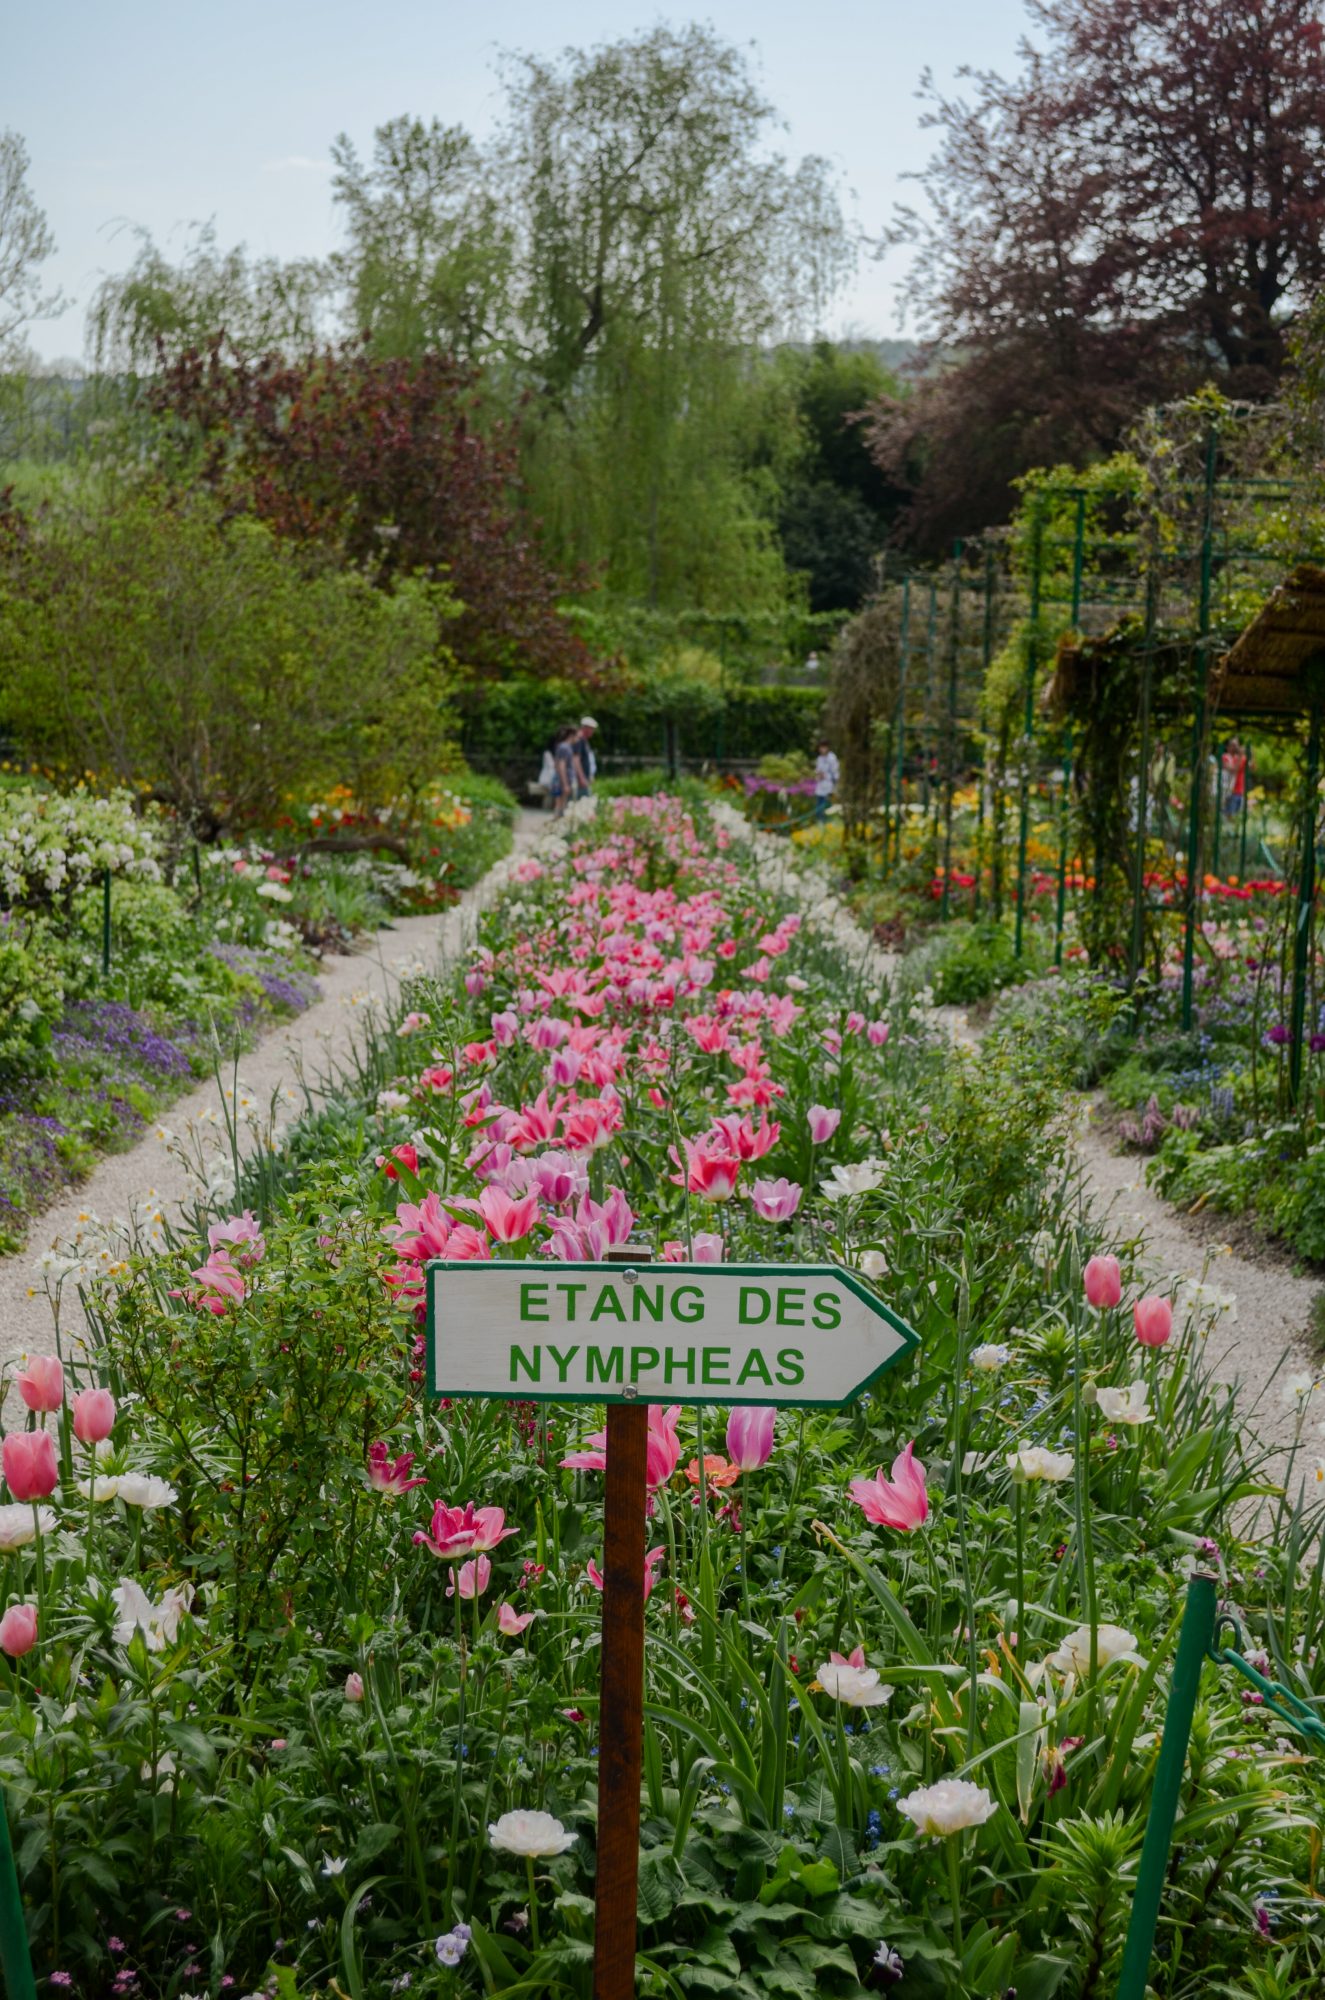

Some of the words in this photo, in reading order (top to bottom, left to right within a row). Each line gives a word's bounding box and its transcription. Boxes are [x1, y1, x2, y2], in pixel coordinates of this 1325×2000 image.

[519, 1283, 706, 1324] ETANG
[738, 1286, 842, 1331] DES
[509, 1344, 806, 1387] NYMPHEAS
